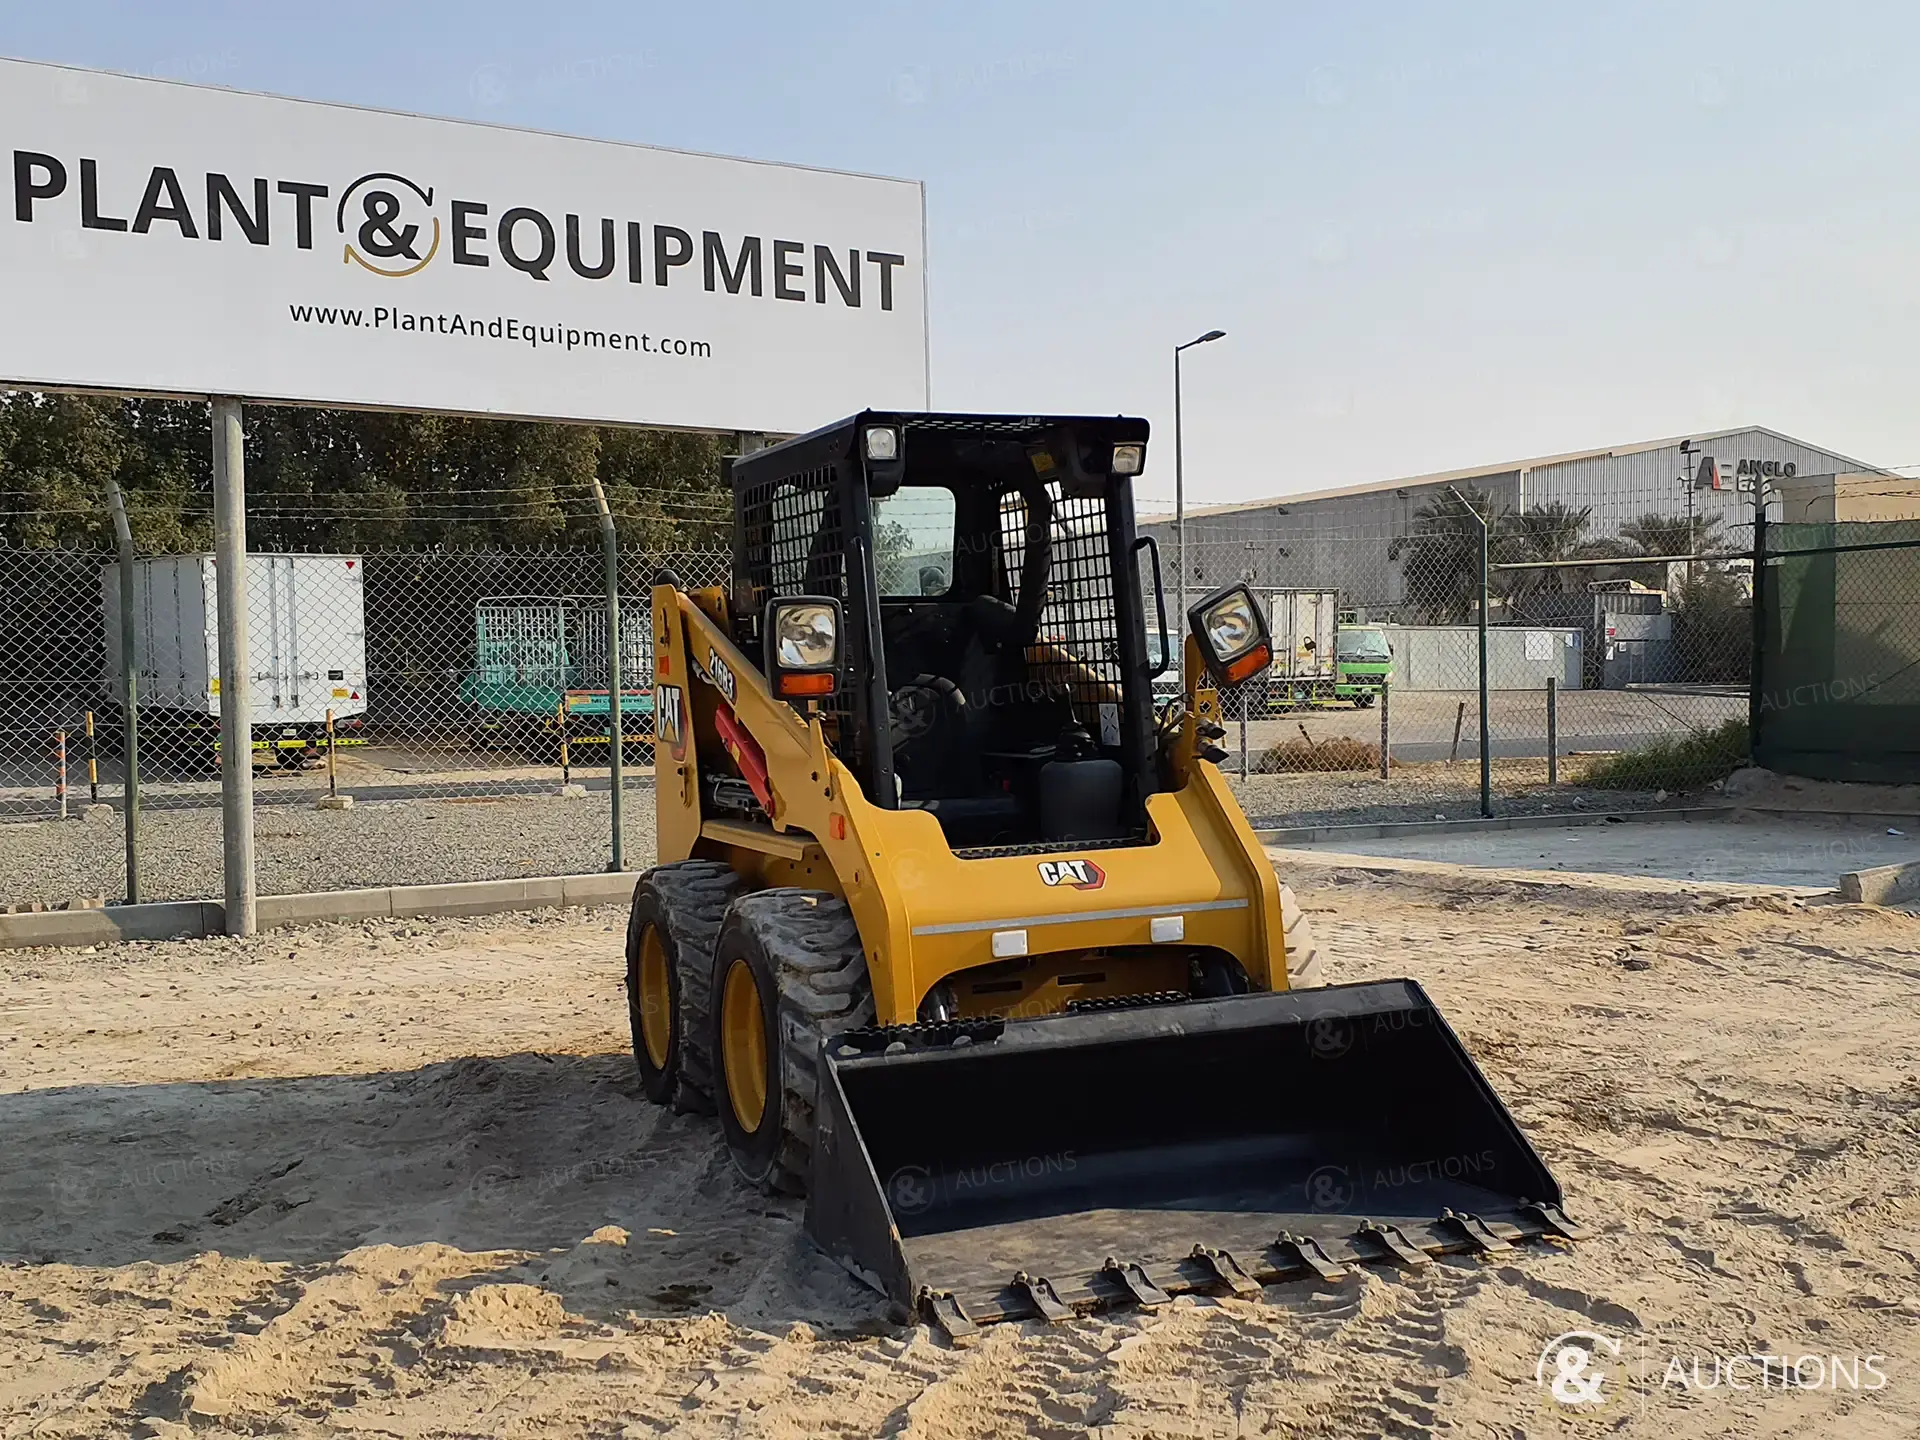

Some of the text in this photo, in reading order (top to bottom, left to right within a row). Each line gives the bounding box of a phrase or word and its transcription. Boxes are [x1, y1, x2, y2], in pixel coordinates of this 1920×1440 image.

[14, 150, 905, 312] PLANT & EQUIPMENT
[289, 304, 712, 358] www.PlantAndEquipment.com
[1737, 459, 1797, 478] ANGLO
[709, 646, 735, 701] 216B3
[656, 684, 681, 744] CAT
[1037, 860, 1090, 887] CAT
